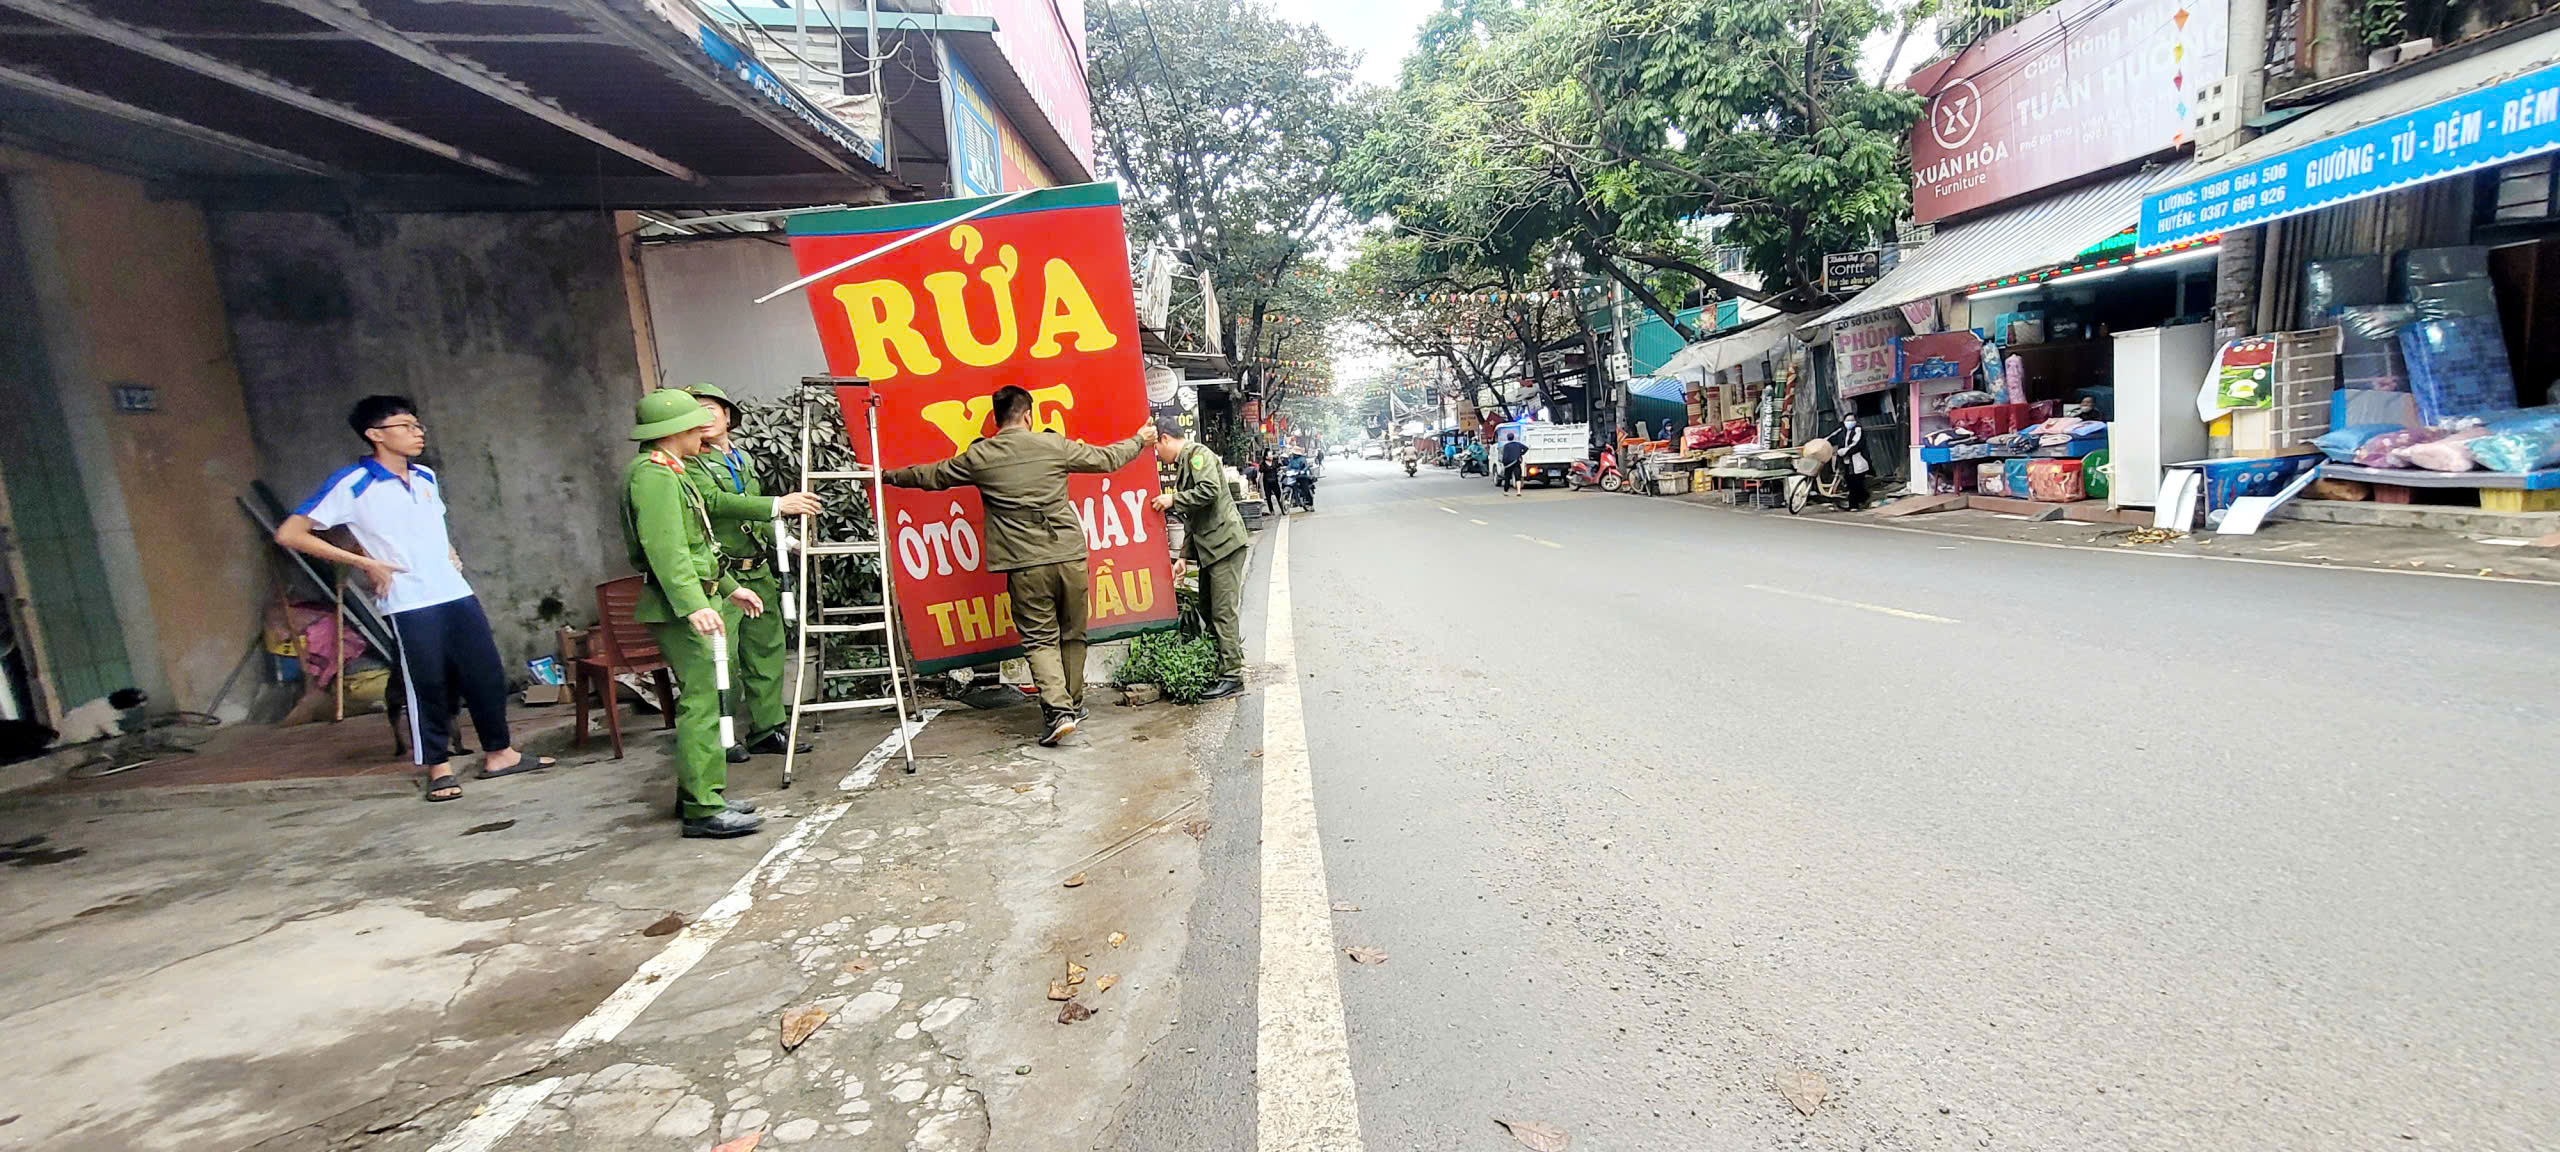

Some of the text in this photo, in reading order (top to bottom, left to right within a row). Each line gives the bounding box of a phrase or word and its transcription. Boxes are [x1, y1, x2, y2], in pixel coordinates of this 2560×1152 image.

[1914, 140, 2009, 189] XUÂN HÒA
[2305, 142, 2377, 189] GIƯỜNG
[2390, 120, 2417, 166] TỦ
[2432, 110, 2482, 158] ĐỆM
[1934, 173, 1987, 198] Furniture
[2201, 179, 2230, 201] 0988
[2234, 171, 2258, 193] 664
[2261, 162, 2288, 184] 506
[2200, 201, 2229, 223] 0387
[2232, 192, 2256, 214] 669
[2260, 186, 2287, 207] 926
[1829, 263, 1865, 276] COFFEE
[832, 224, 1118, 382] RỬA
[1839, 325, 1899, 354] PHÔN
[897, 478, 1148, 580] ÔTÔ MÁY
[927, 558, 1155, 647] THA ẦU
